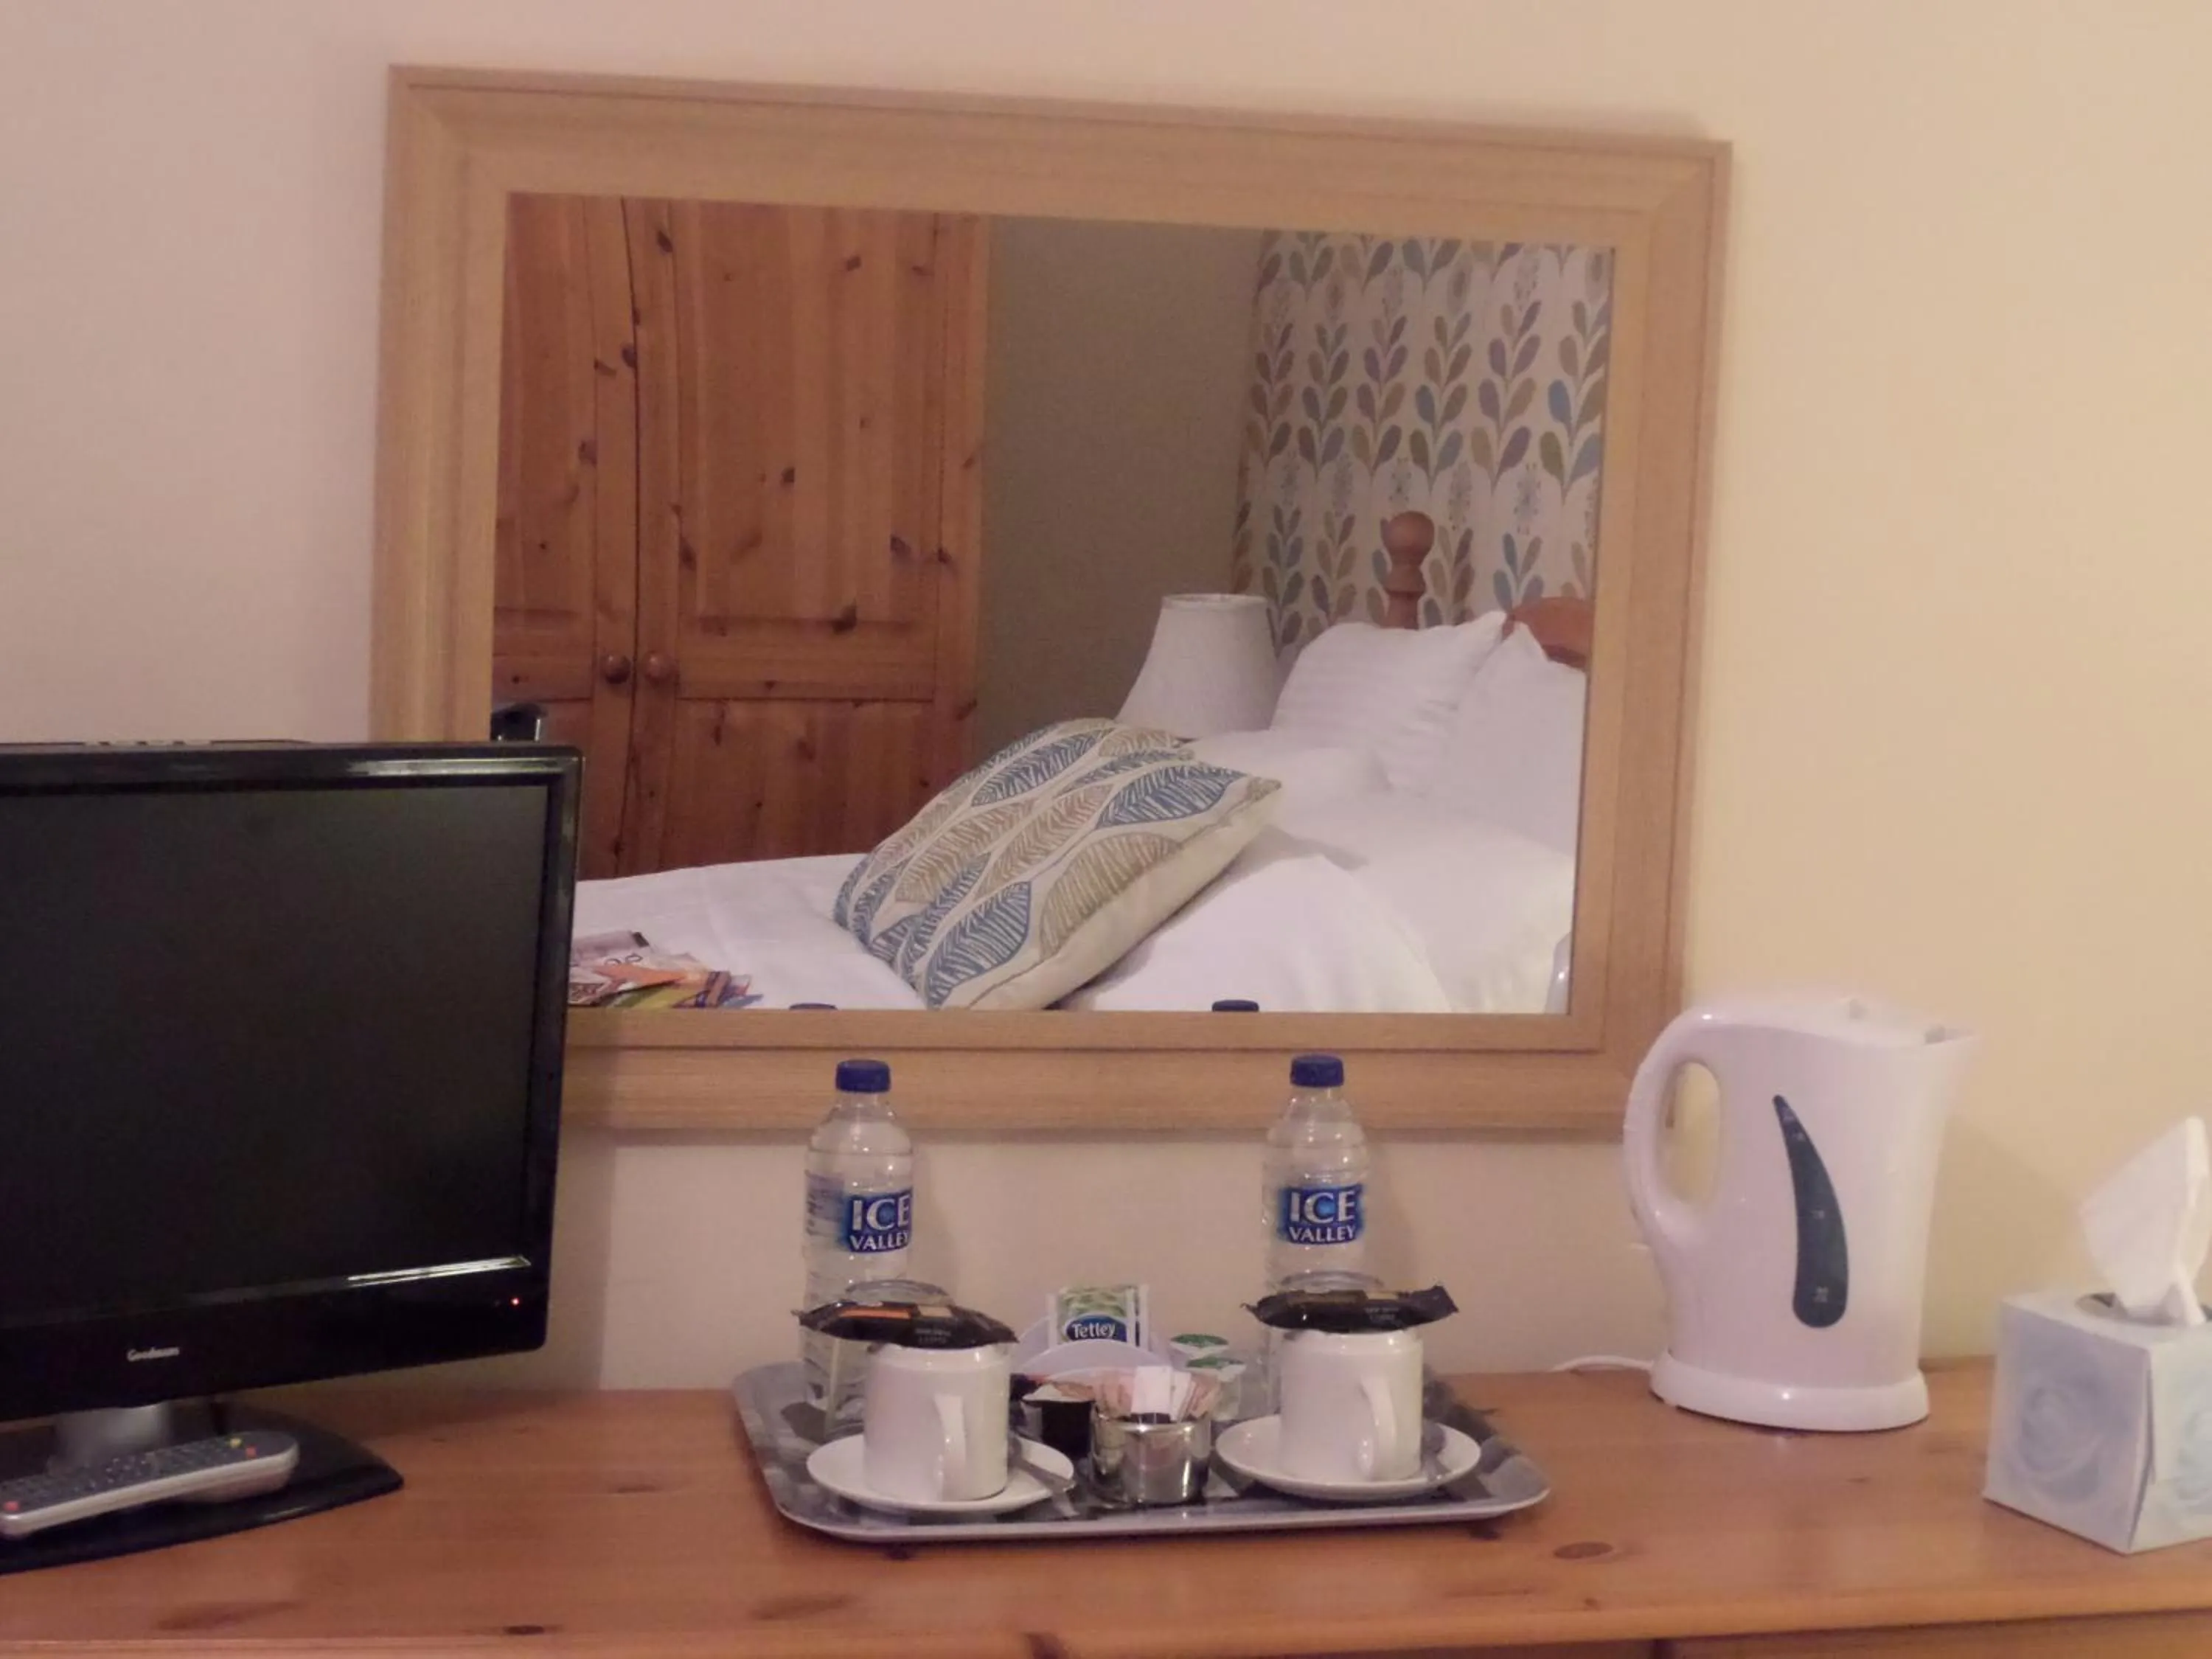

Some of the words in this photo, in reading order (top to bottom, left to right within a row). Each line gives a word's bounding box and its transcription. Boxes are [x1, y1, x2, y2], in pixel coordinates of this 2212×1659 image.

[852, 1194, 910, 1231] ICE
[1290, 1190, 1355, 1224] ICE
[849, 1231, 908, 1251] VALLEY
[1289, 1225, 1355, 1242] VALLEY
[1072, 1322, 1116, 1338] Tetley
